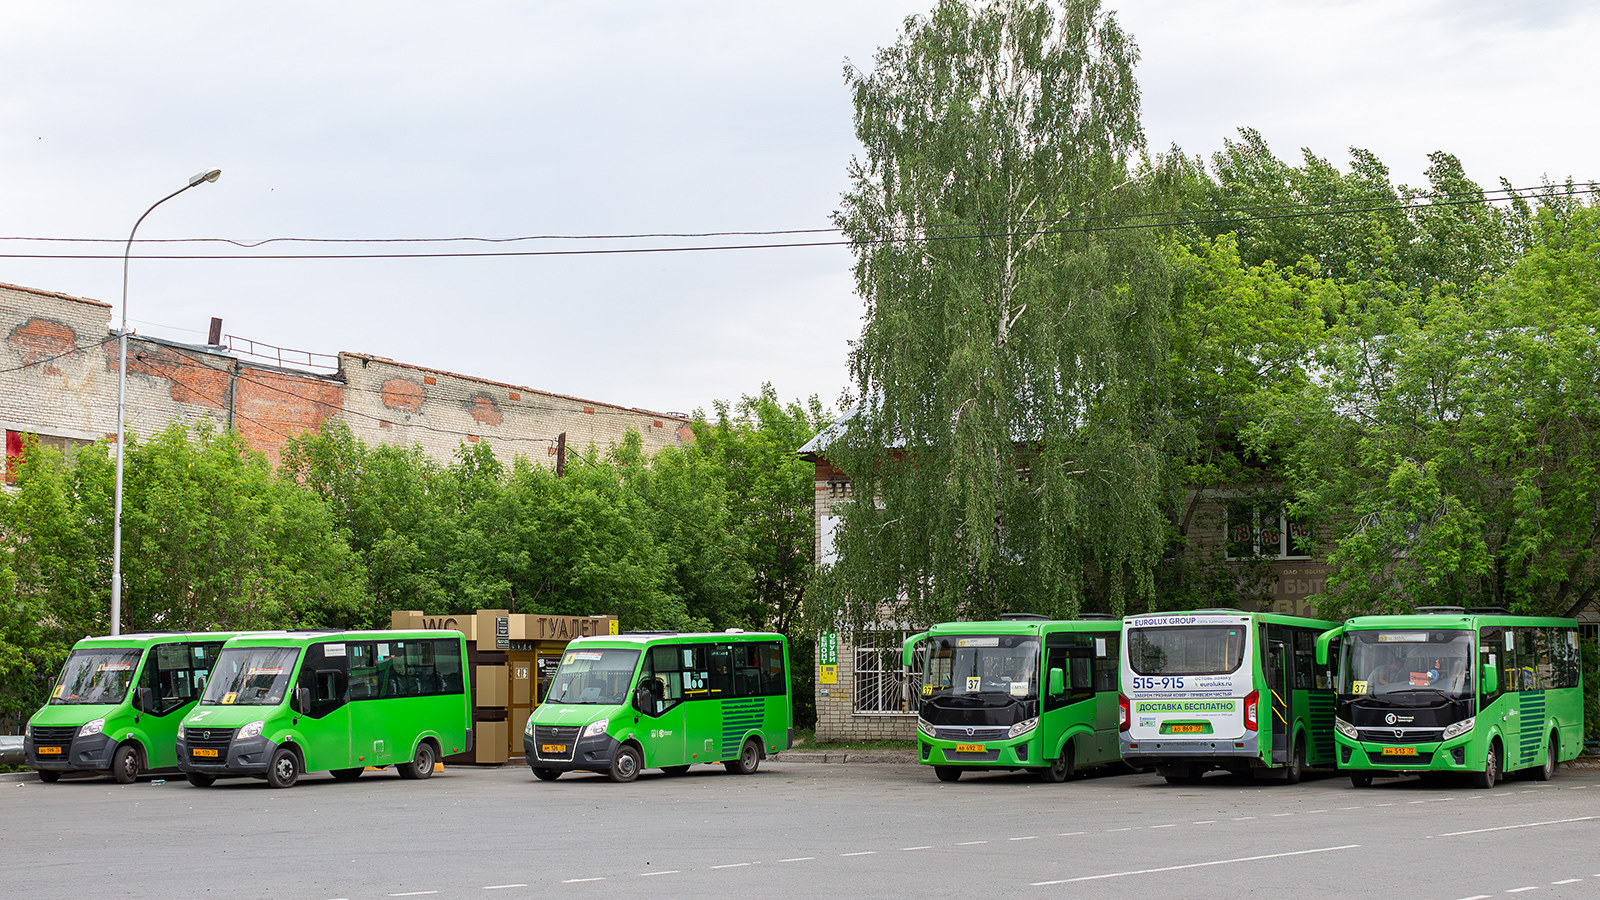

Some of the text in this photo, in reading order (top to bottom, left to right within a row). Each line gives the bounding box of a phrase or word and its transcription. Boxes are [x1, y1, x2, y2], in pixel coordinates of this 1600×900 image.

[1134, 617, 1196, 627] EUROLUX GROUP
[537, 617, 599, 638] ТУАЛЕТ
[829, 633, 837, 663] ОБУВИ
[967, 679, 979, 690] 37
[1132, 677, 1184, 689] 515-915
[923, 686, 932, 694] 37
[1354, 684, 1366, 693] 37
[1139, 702, 1233, 712] ДОСТАВКА БЕСПЛАТНО
